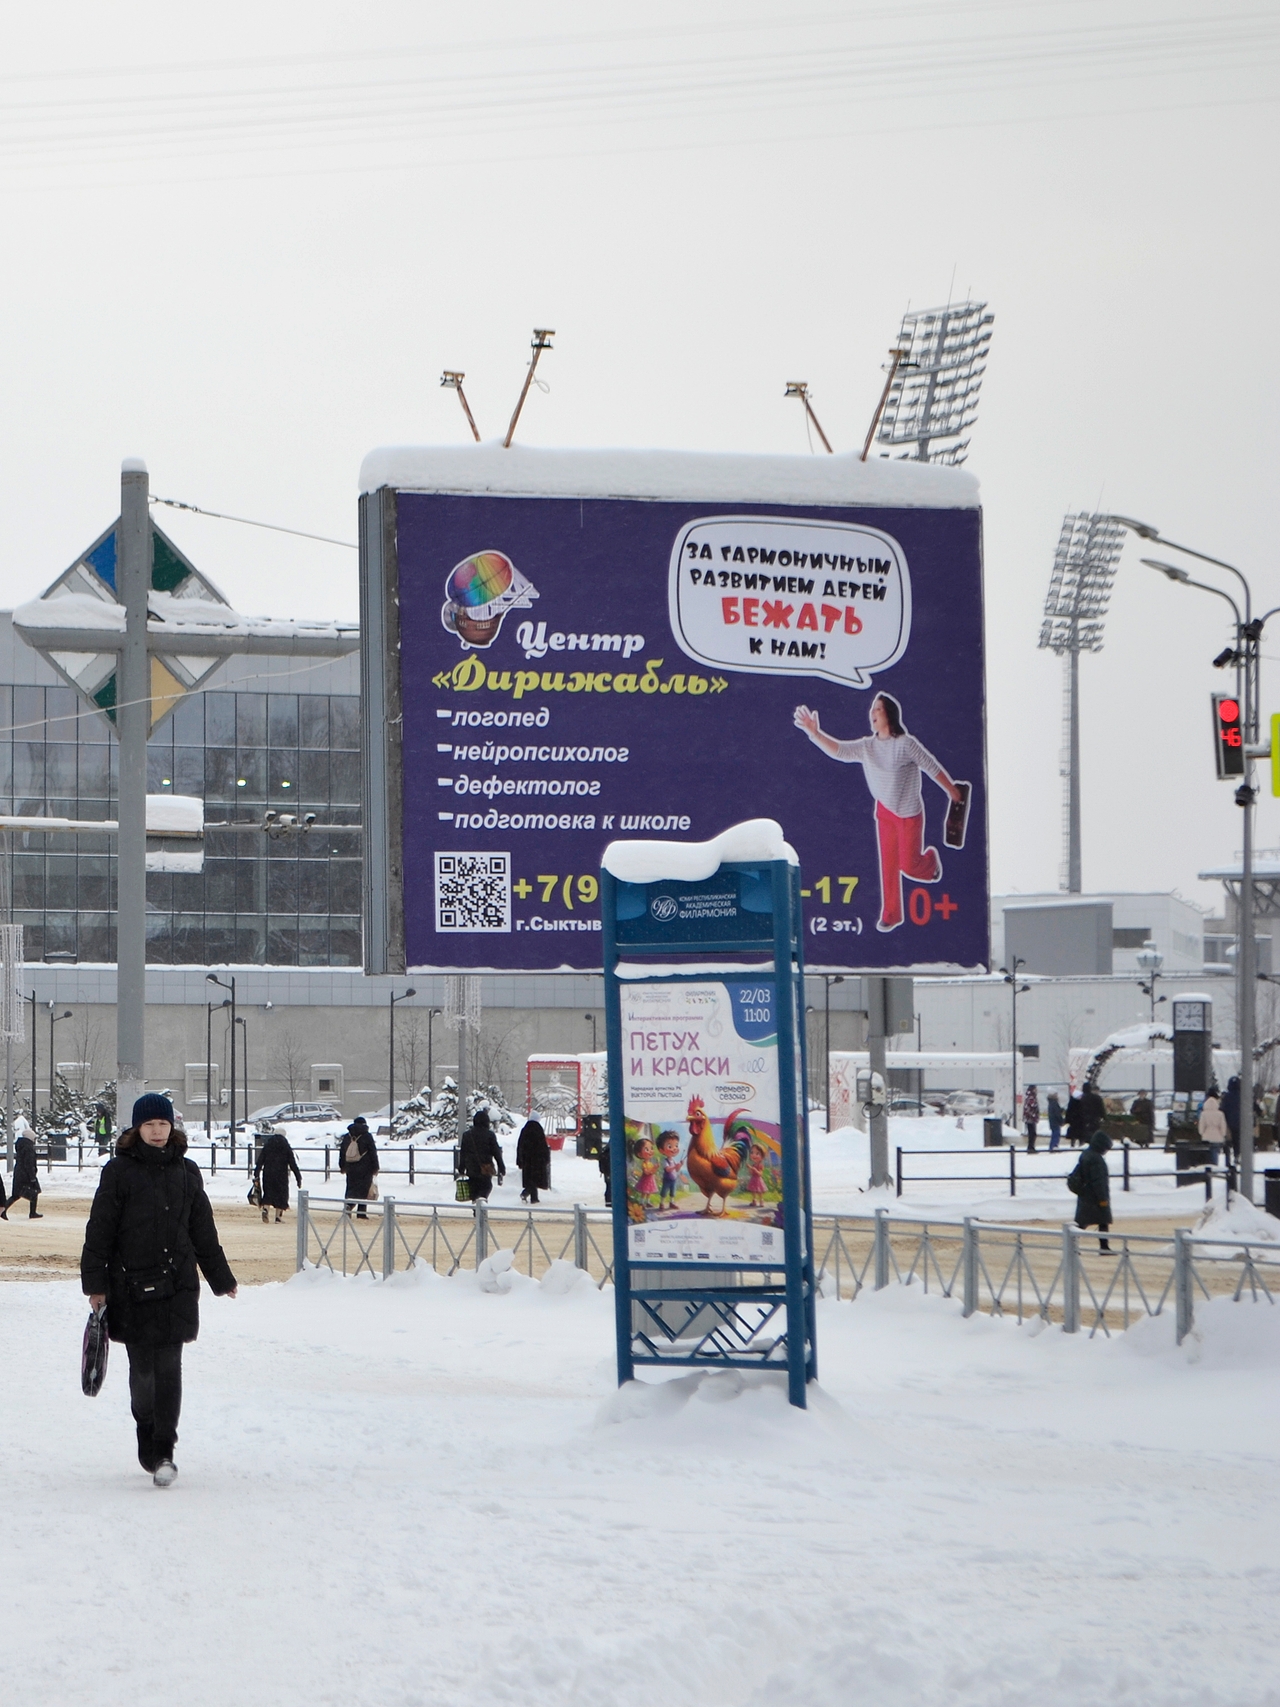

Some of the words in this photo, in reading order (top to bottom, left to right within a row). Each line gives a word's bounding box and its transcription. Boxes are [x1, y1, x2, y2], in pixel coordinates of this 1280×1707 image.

[686, 542, 712, 560] ЗА
[721, 546, 892, 576] ГАРМОНИЧНЫМ
[690, 568, 815, 595] РАЗВИТИЕМ
[823, 577, 888, 601] ДЕТЕЙ
[721, 596, 863, 635] БЕЖАТЬ
[516, 621, 645, 659] Центр
[749, 637, 763, 655] К
[771, 639, 826, 659] НАМ!
[432, 654, 728, 699] «Дирижабль»
[1221, 727, 1242, 747] 46
[602, 814, 615, 831] к
[620, 813, 691, 831] школе
[679, 907, 737, 919] ФИЛАРМОНИЯ
[909, 887, 958, 926] 0+
[810, 916, 828, 935] (2
[740, 988, 771, 1004] 22/03
[744, 1008, 771, 1023] 11:00
[630, 1031, 700, 1051] ПЕТУХ
[631, 1057, 643, 1076] И
[652, 1056, 730, 1077] КРАСКИ
